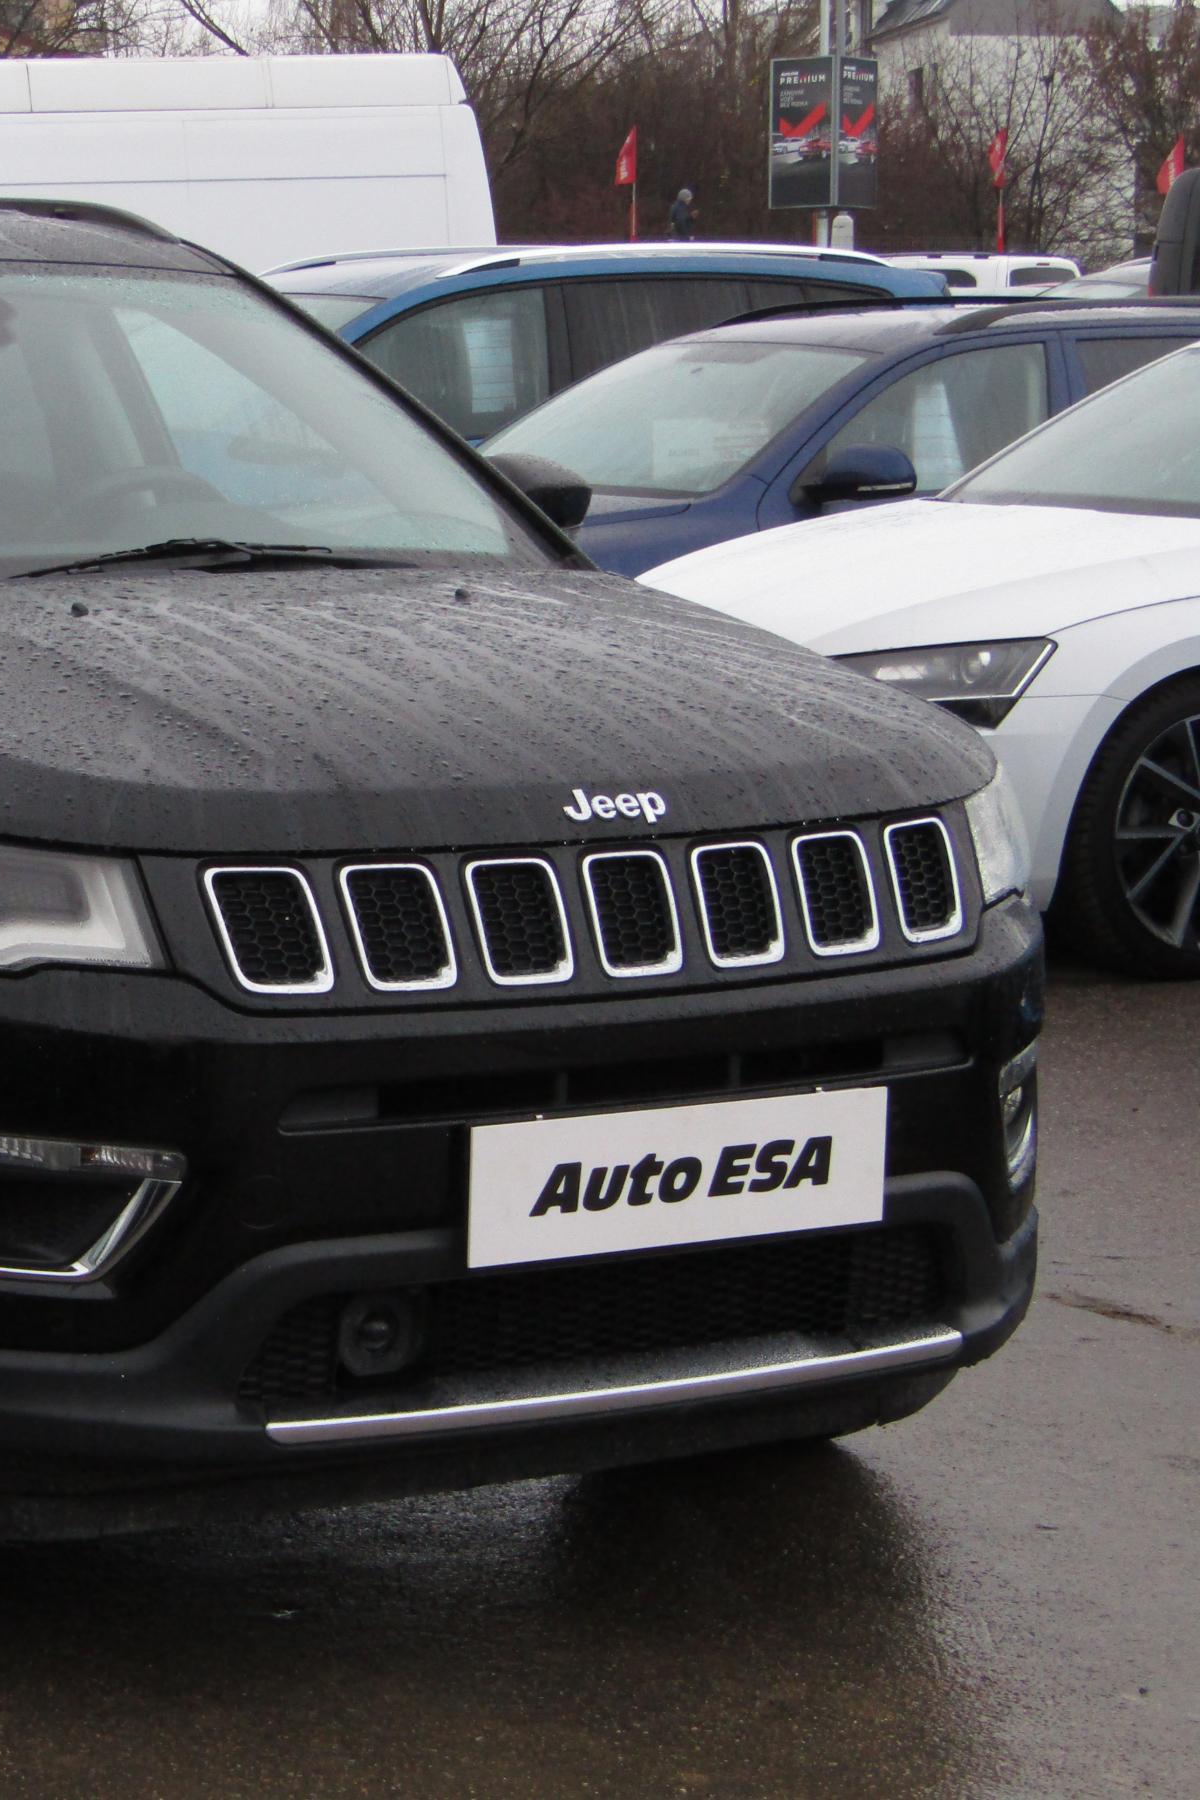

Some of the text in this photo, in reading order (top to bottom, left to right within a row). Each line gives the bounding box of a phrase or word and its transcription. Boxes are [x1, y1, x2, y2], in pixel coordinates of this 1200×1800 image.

[780, 74, 826, 85] PREMIUM
[563, 788, 666, 823] Jeep
[529, 1135, 833, 1217] Auto ESA
